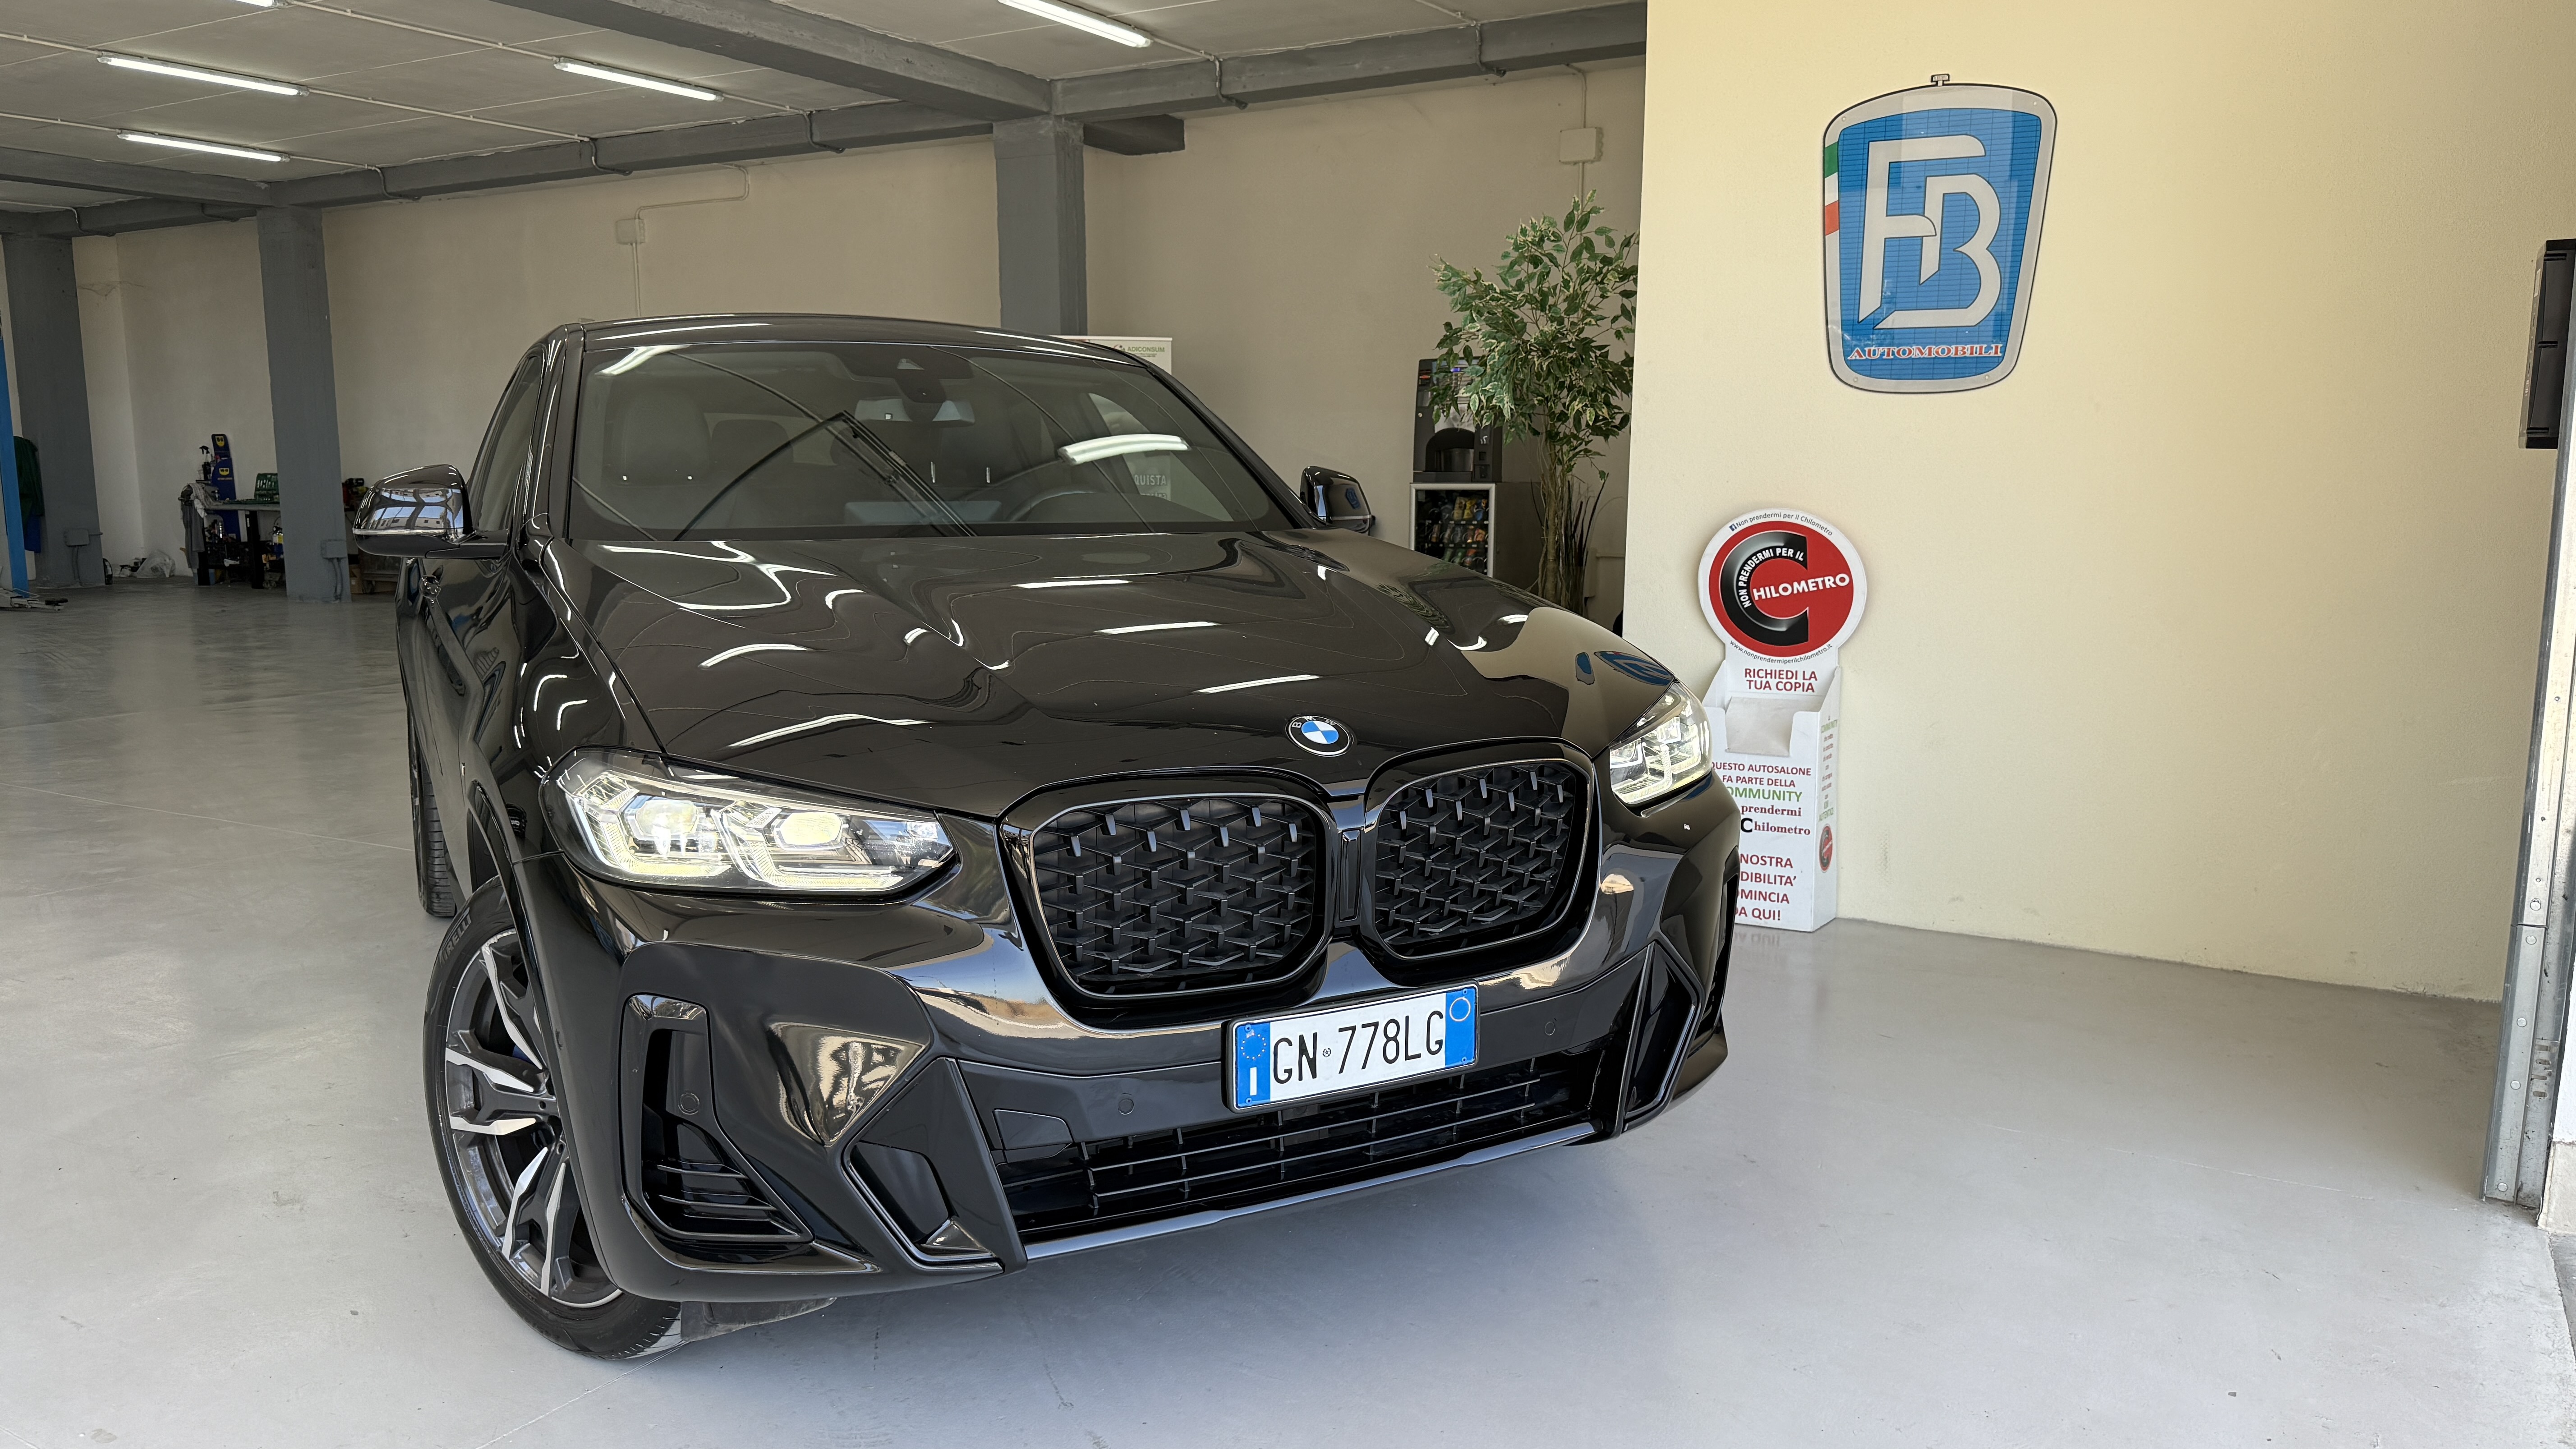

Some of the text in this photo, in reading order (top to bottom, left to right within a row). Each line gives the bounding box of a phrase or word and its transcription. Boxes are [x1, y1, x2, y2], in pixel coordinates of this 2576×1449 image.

[1848, 344, 2003, 360] AUTOMOBILI
[1134, 474, 1167, 485] QUISTA
[1736, 520, 1748, 528] Non
[1749, 512, 1781, 523] prendermi
[1800, 516, 1833, 536] Chilometro
[1739, 547, 1804, 608] NON PRENDERMI PER IL
[1730, 640, 1833, 664] www.nonprendermiperilchilometro.it
[1744, 668, 1818, 681] RICHIEDI LA
[1746, 680, 1815, 693] TUA COPIA
[1292, 716, 1336, 728] BMW
[1748, 764, 1812, 776] AUTOSALONE
[1722, 775, 1796, 787] FA PARTE DELLA
[1726, 787, 1803, 802] MMUNITY
[1741, 805, 1802, 817] prendermi
[1740, 818, 1811, 835] Chilometro
[1740, 853, 1793, 869] NOSTRA
[1740, 871, 1797, 887] DIBILITA'
[1738, 889, 1789, 904] MINCIA
[1752, 908, 1780, 920] QUI!
[1273, 1010, 1444, 1084] GN 778LG
